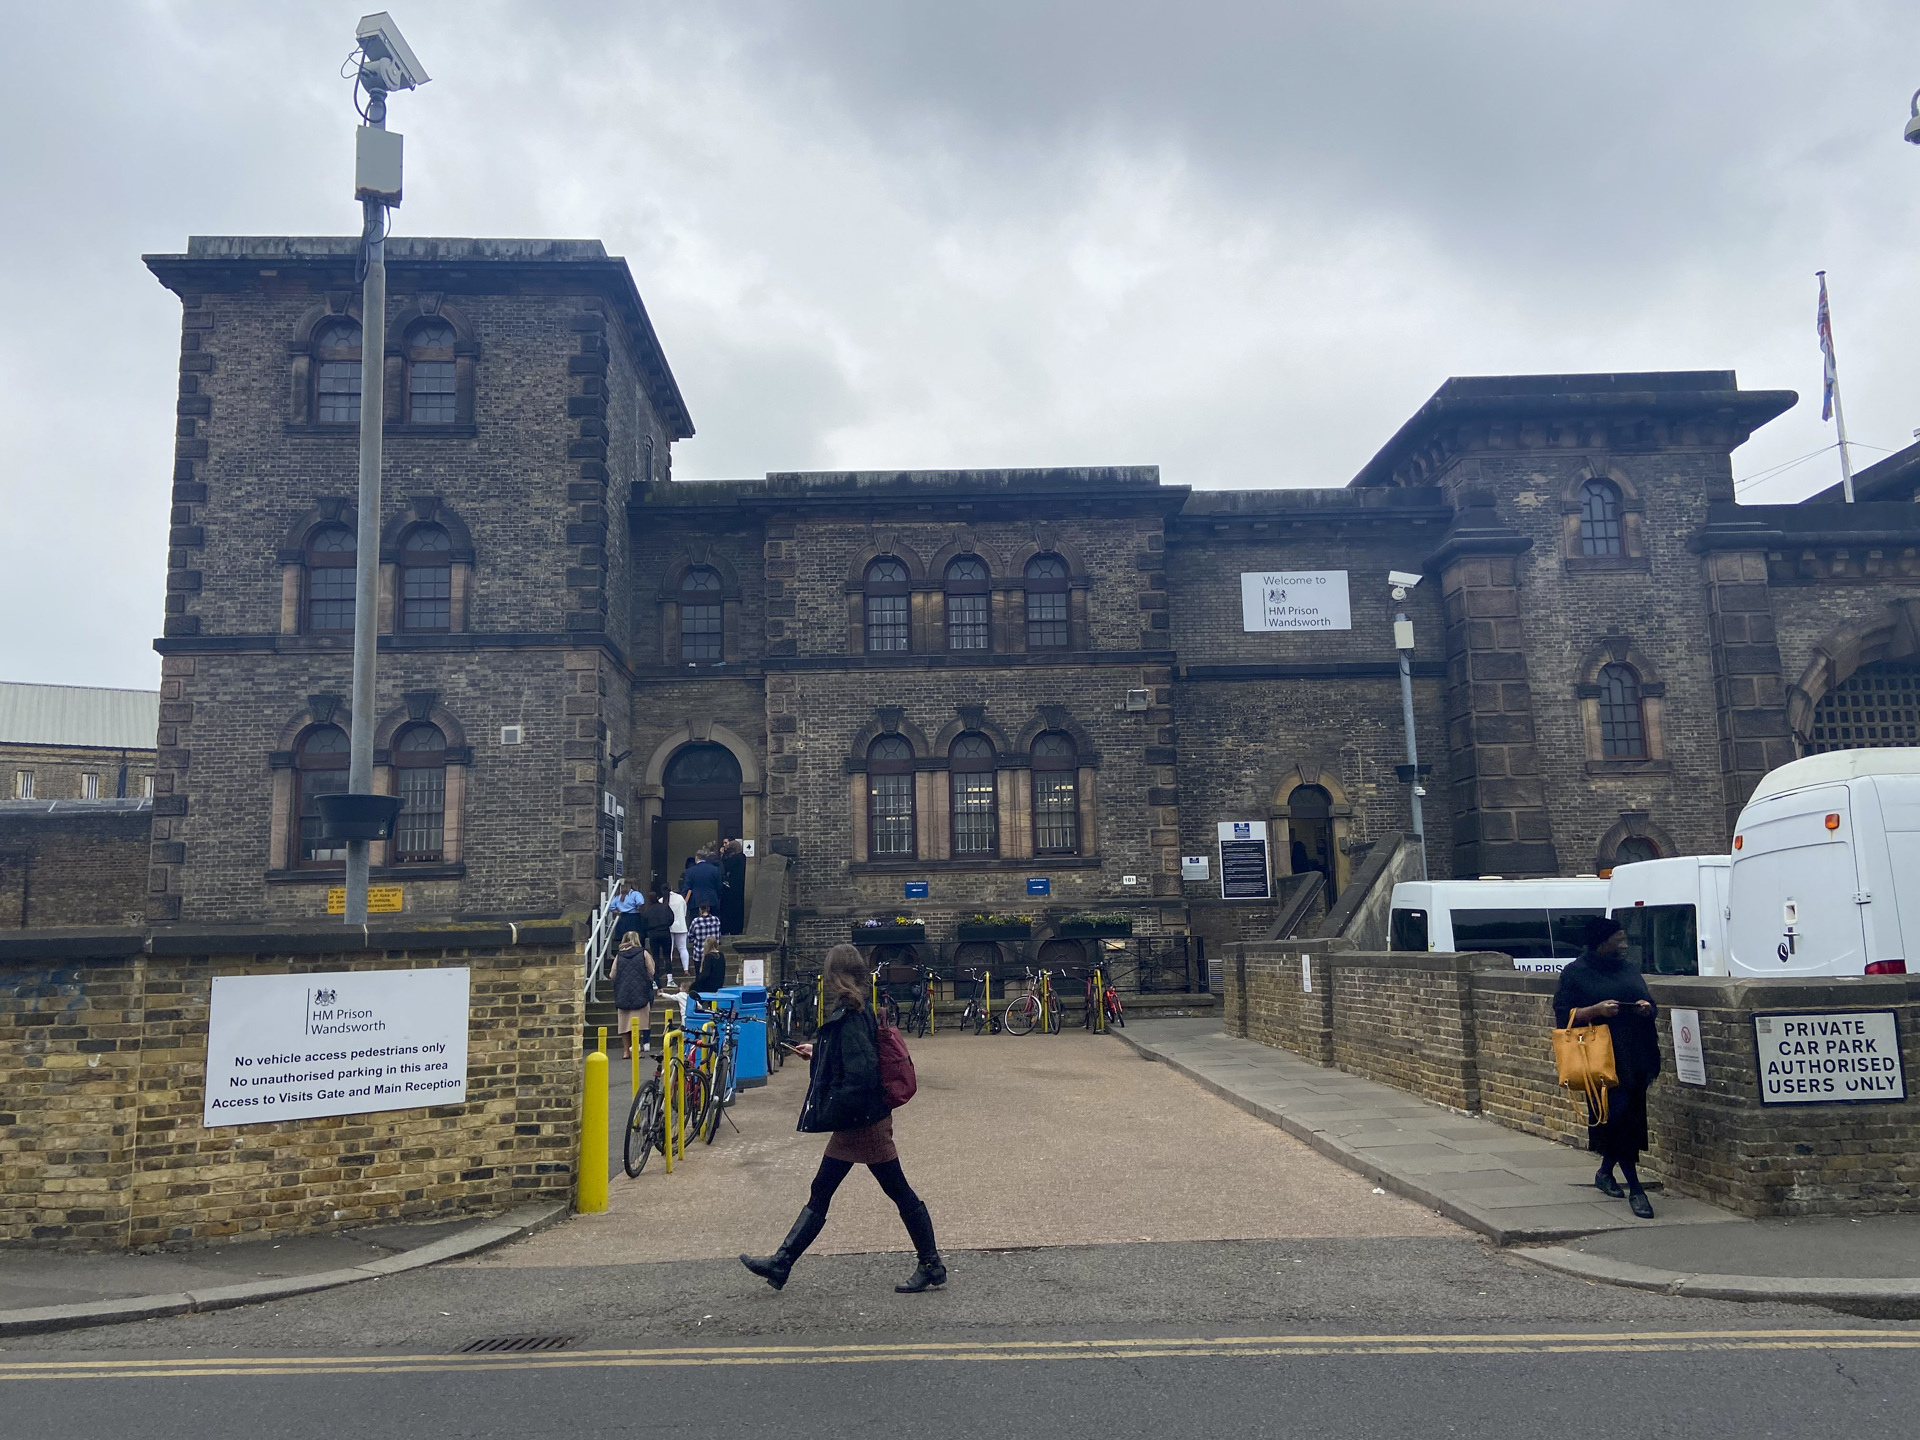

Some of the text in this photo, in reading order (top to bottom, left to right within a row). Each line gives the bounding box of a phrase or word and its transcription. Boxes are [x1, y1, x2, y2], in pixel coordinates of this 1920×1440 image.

[1263, 576, 1312, 585] Welcome
[1269, 607, 1318, 615] HM Prison
[1269, 617, 1331, 626] Wandsworth
[312, 1008, 373, 1021] HM Prison
[311, 1020, 386, 1035] Wandsworth
[1784, 1021, 1865, 1036] PRIVATE
[235, 1042, 446, 1067] No vehicle access pedestrians only
[1779, 1039, 1877, 1055] CAR PARK
[1768, 1057, 1895, 1075] AUTHORISED
[230, 1061, 448, 1088] No unauthorised parking in this area
[212, 1078, 461, 1109] Access to Visits Gate and Main Reception
[1769, 1078, 1835, 1094] USERS
